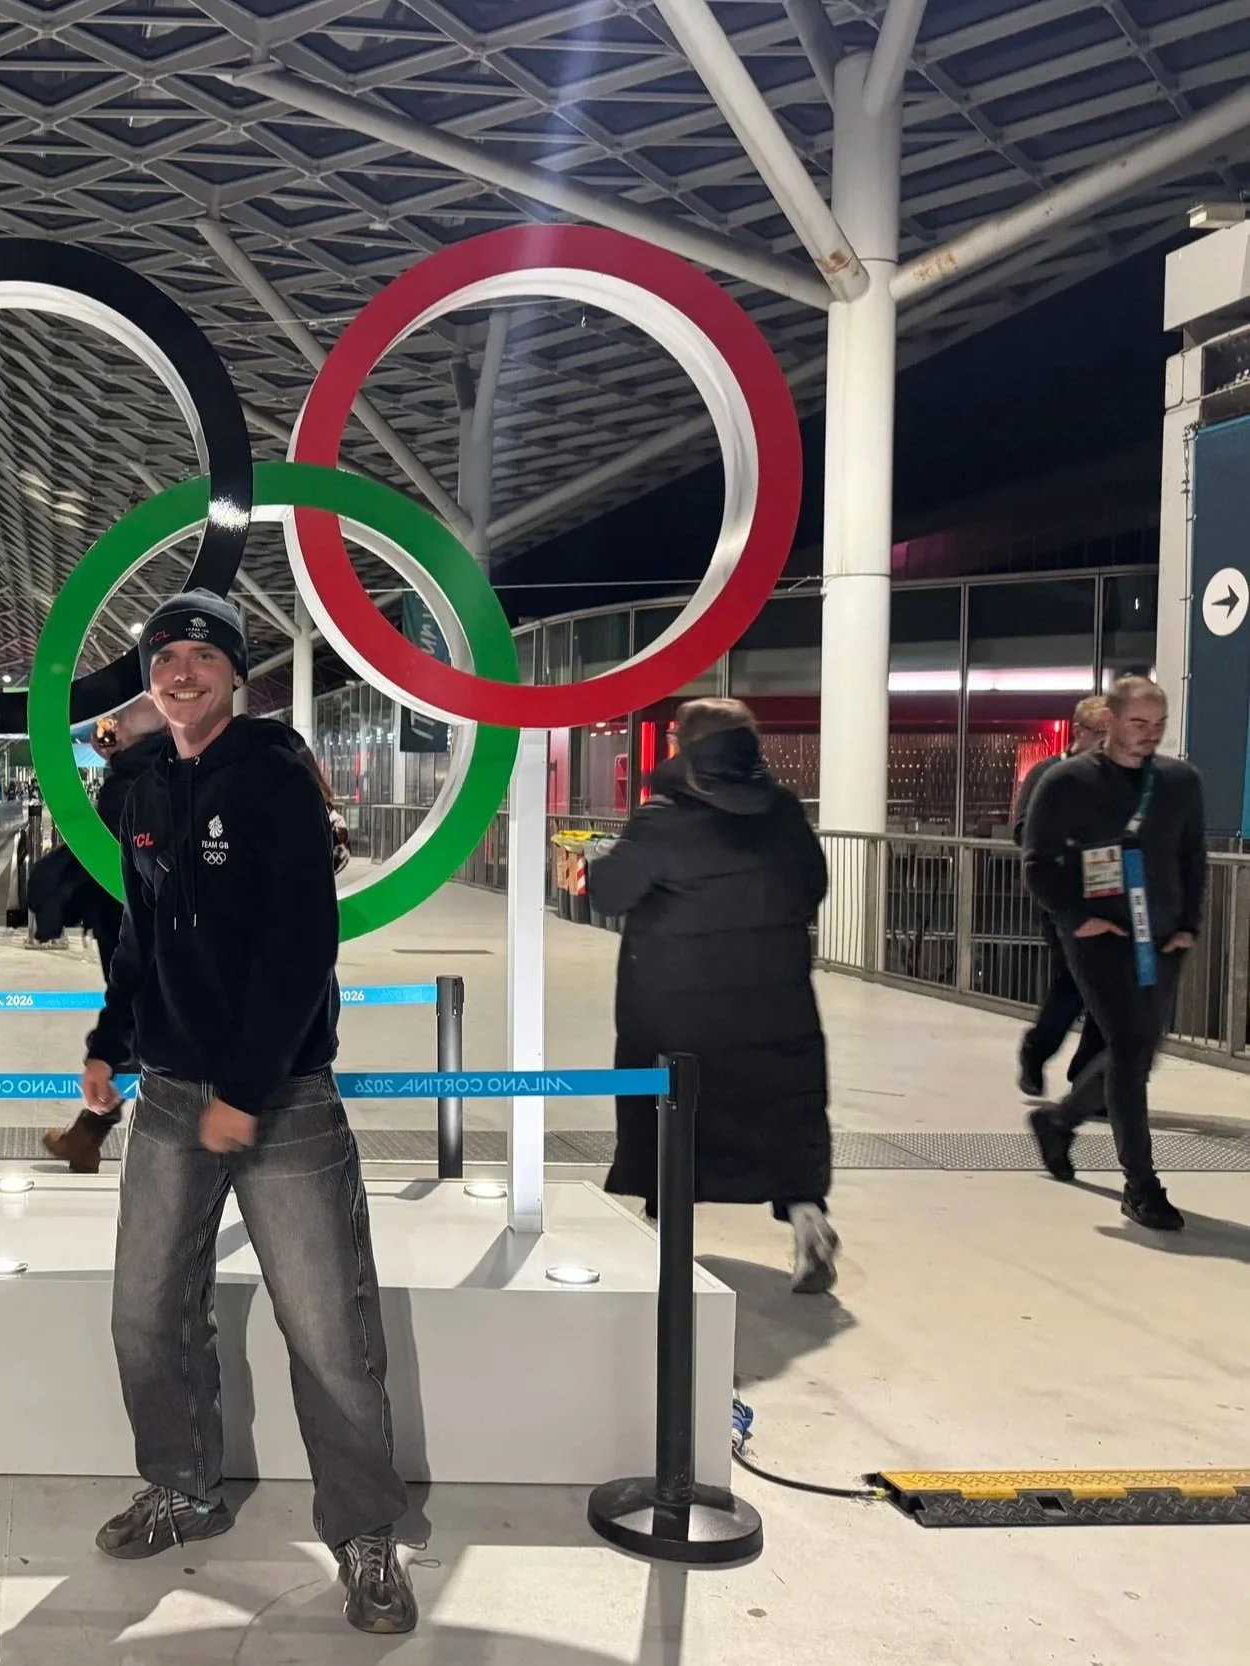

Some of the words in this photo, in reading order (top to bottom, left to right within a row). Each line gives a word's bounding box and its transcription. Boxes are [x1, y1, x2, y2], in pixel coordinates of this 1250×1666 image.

[201, 840, 218, 849] TEAM
[218, 841, 229, 850] GB
[6, 995, 34, 1006] 2026
